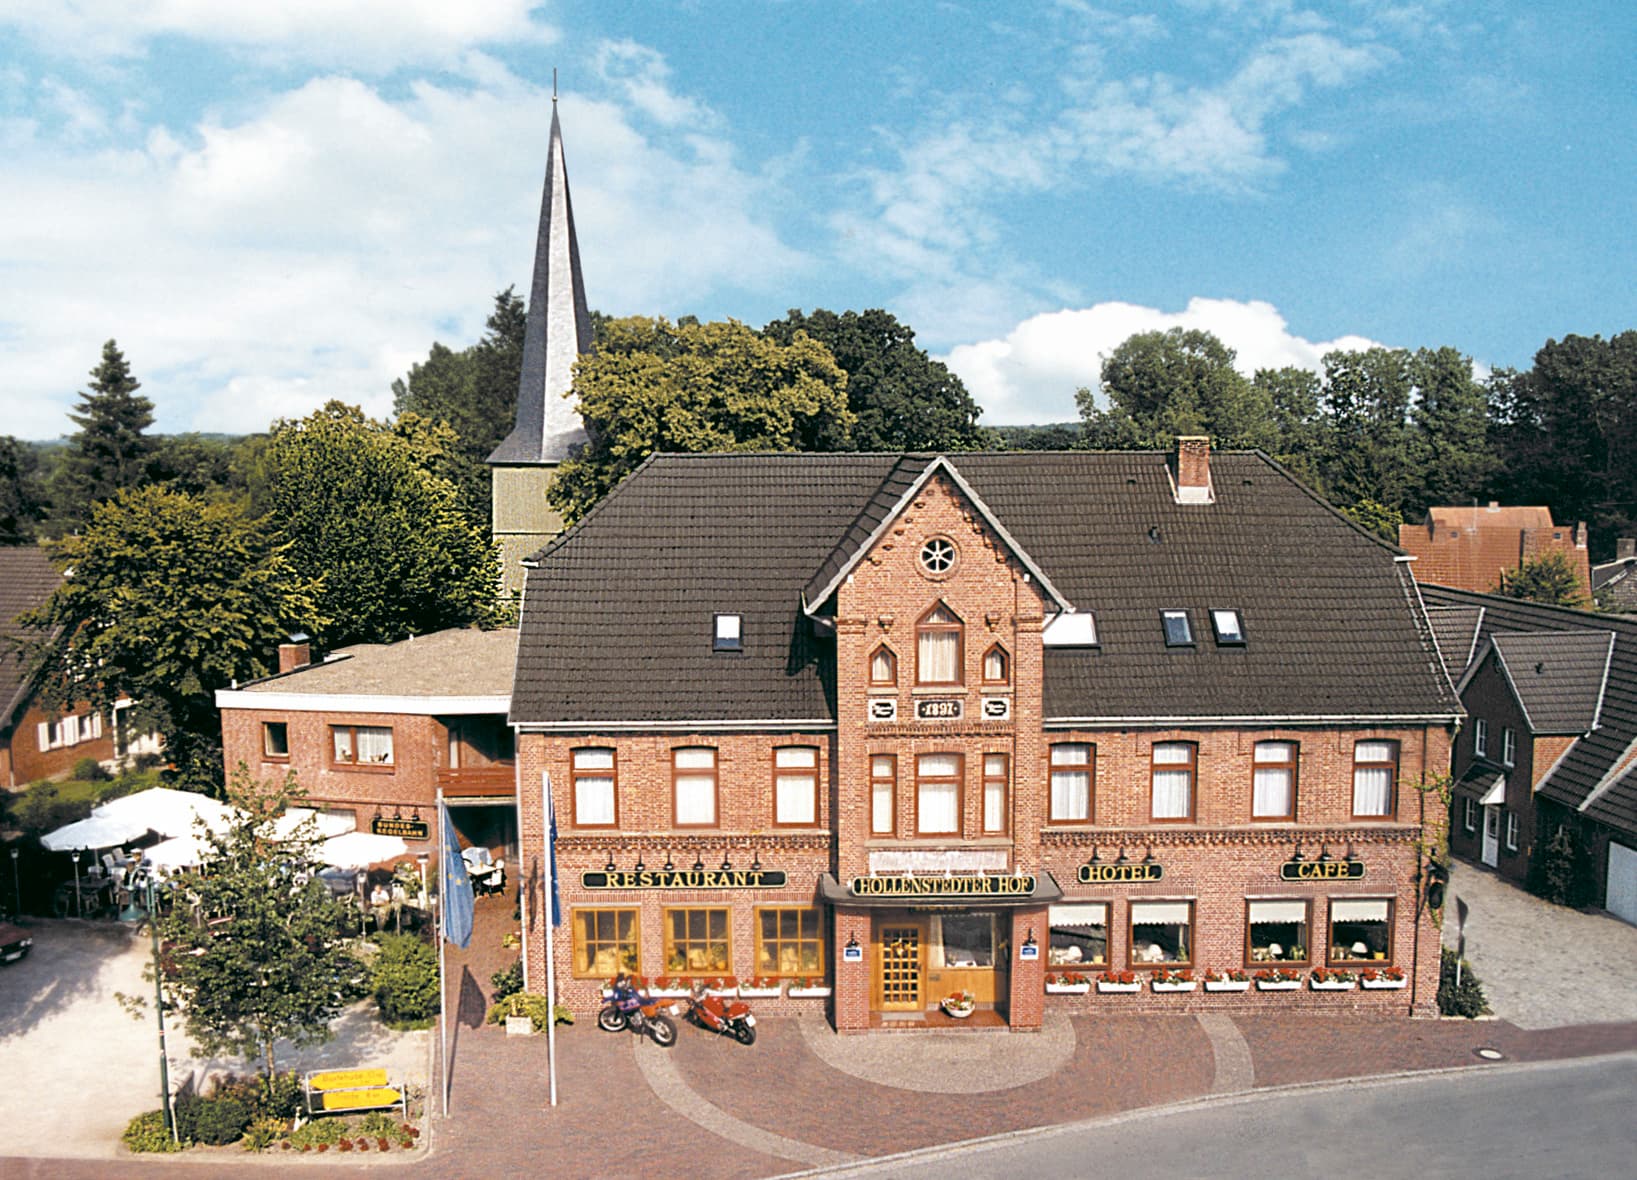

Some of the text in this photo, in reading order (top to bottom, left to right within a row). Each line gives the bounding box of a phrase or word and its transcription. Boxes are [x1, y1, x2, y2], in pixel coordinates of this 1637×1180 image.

[925, 702, 955, 716] 1897
[605, 871, 764, 888] RESTAURANT
[1088, 865, 1156, 881] HOTEL
[860, 876, 1031, 894] HOLLENSTEDTER HOF
